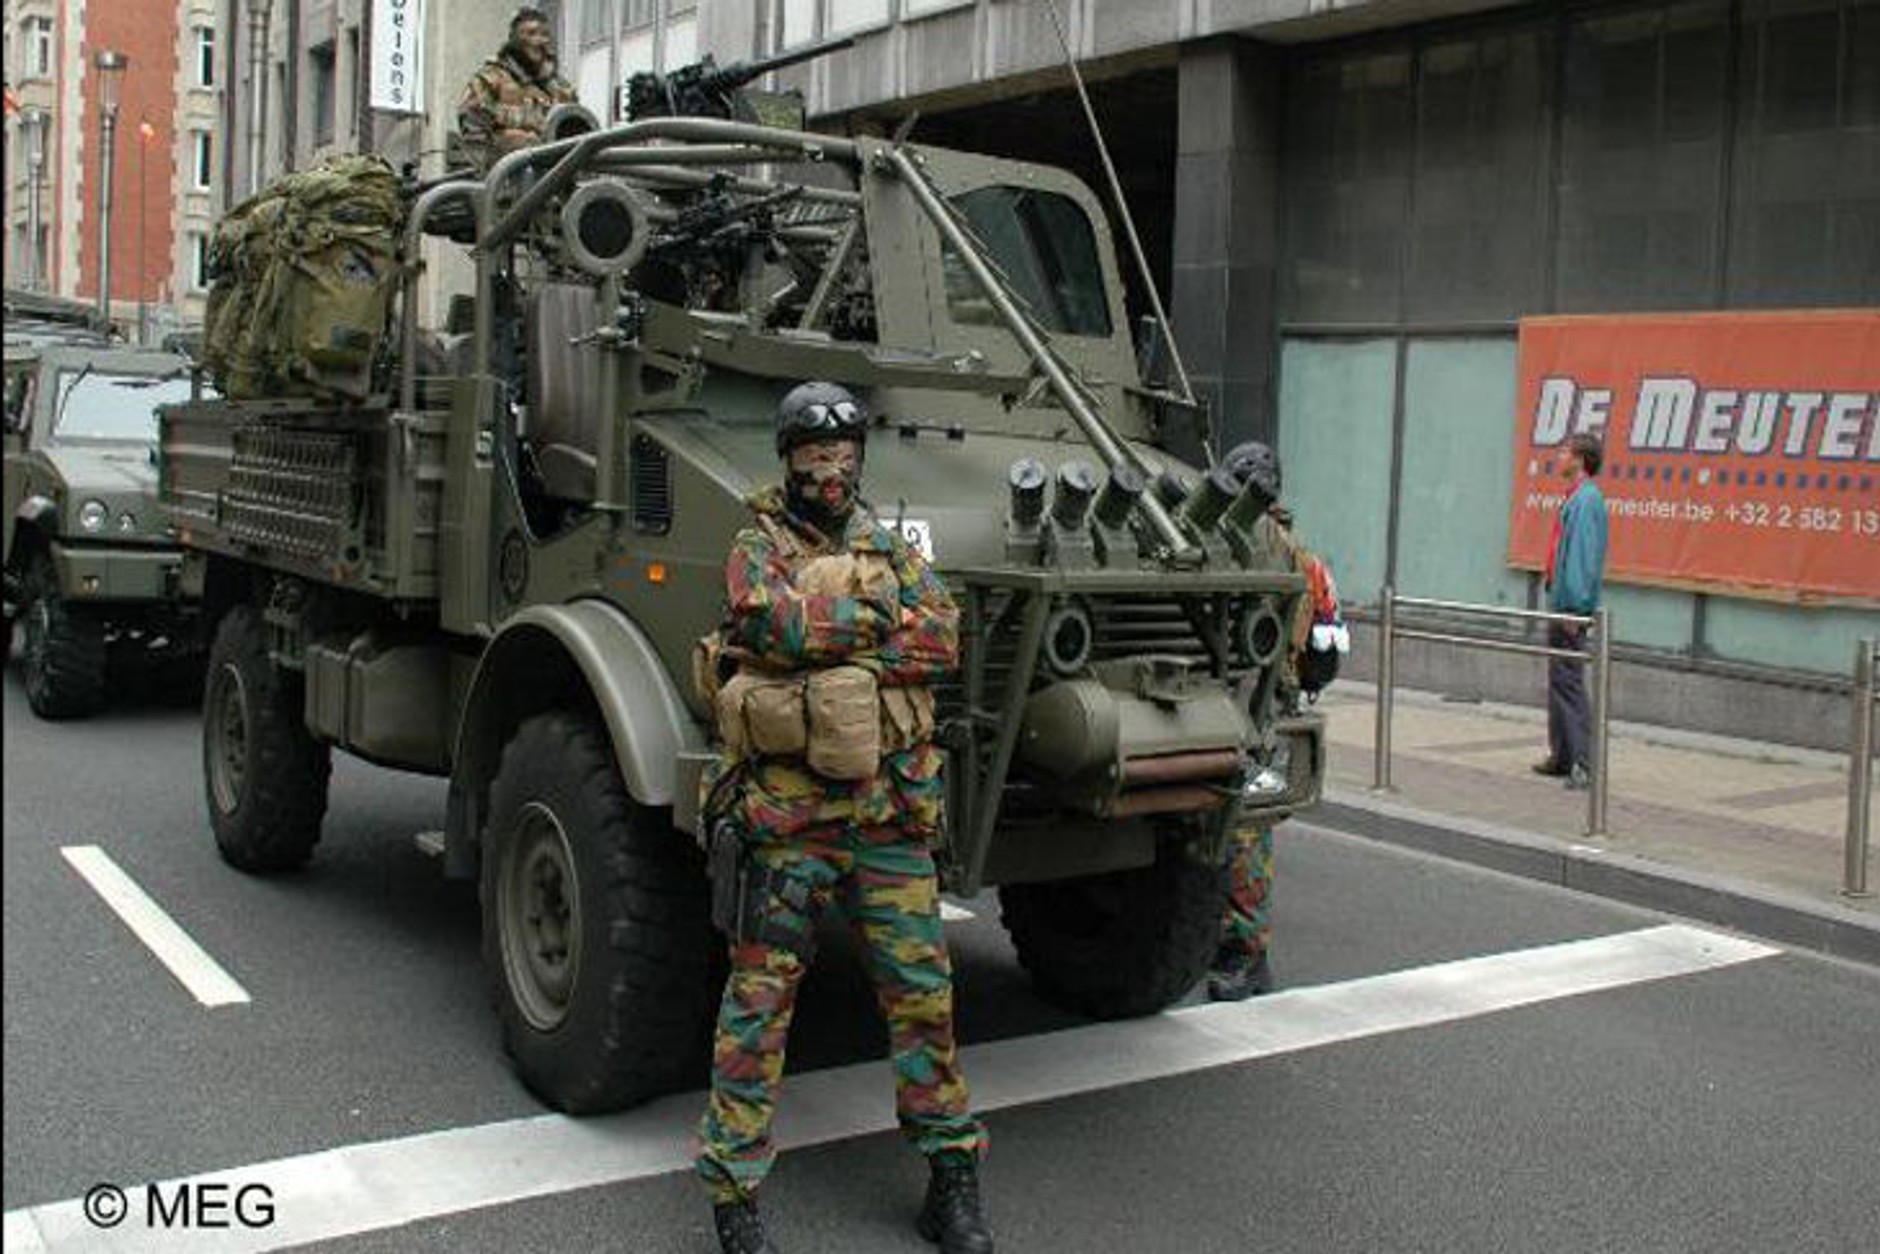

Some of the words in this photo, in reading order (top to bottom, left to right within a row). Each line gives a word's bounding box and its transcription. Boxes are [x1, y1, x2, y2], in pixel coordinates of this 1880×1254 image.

[1725, 502, 1770, 527] +32
[1777, 503, 1792, 529] 2
[1799, 507, 1842, 531] 582
[1852, 510, 1880, 534] 13
